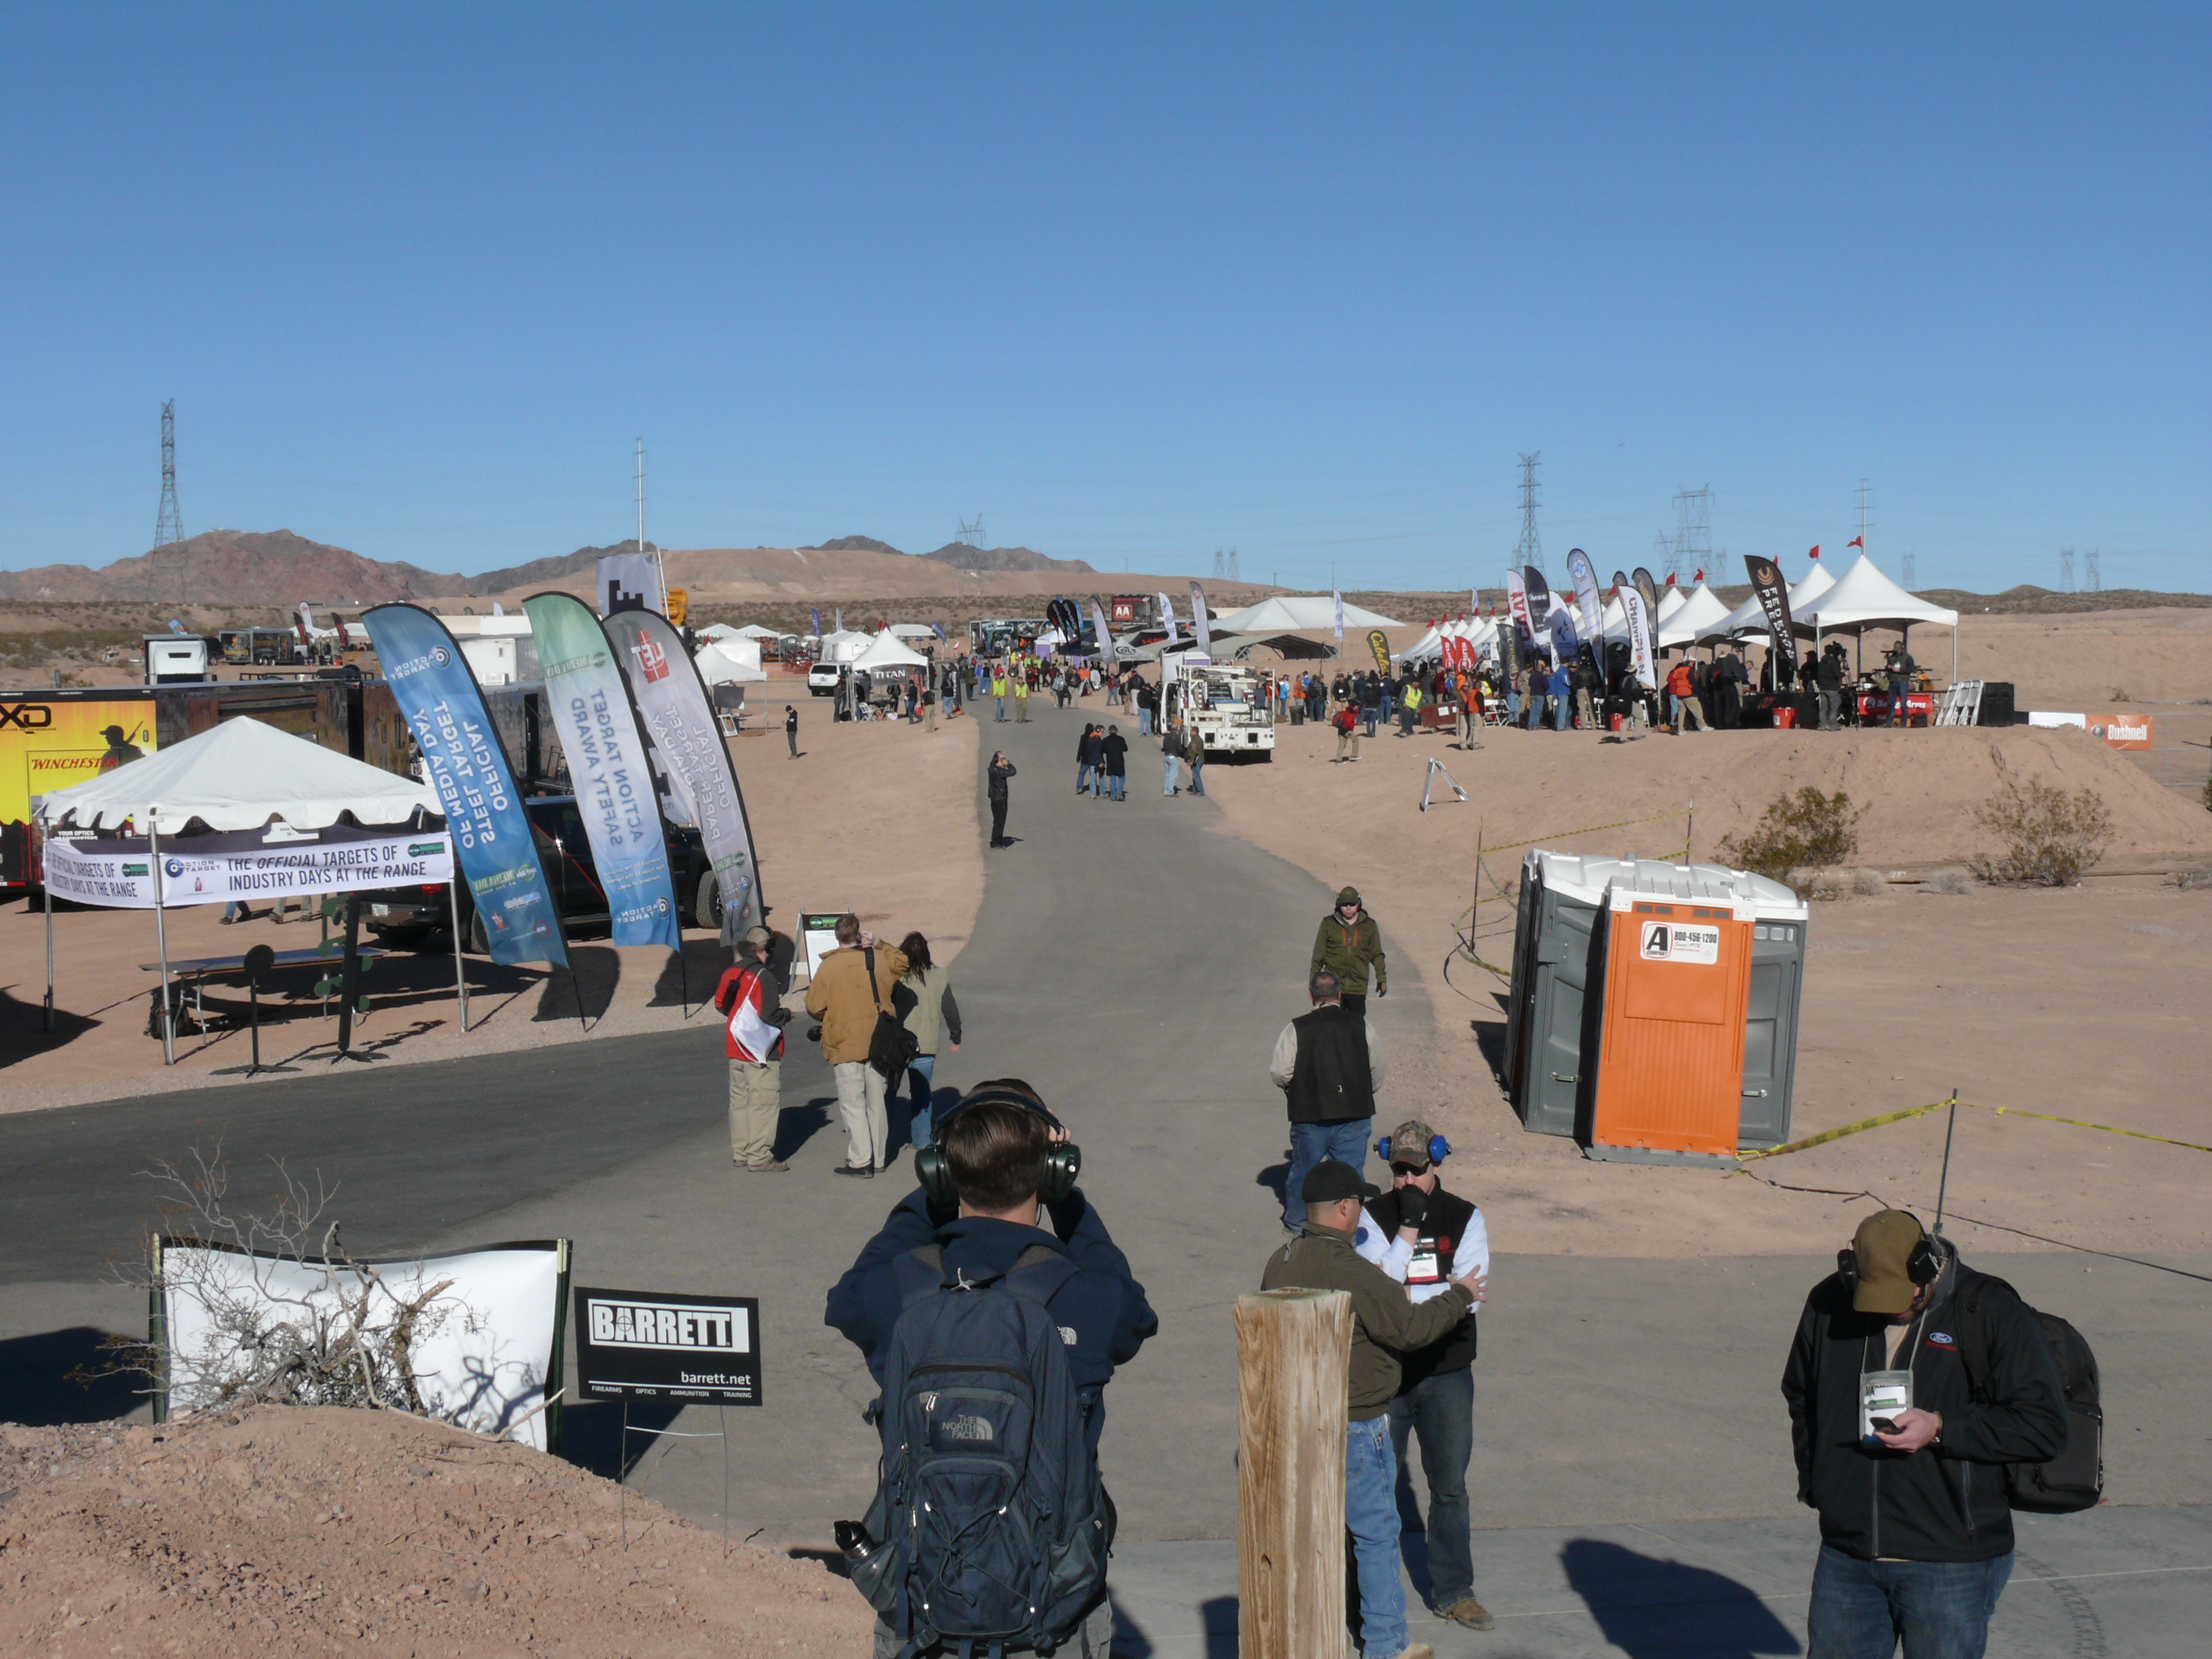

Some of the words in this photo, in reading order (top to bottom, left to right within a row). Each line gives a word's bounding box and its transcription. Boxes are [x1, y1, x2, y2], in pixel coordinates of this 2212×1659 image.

[1629, 596, 1646, 675] CHAMPION
[874, 669, 906, 680] TITAN
[1906, 700, 1926, 709] Arms
[2108, 725, 2147, 740] Bushnell
[32, 757, 117, 770] WINCHESTER
[227, 858, 251, 872] THE
[257, 853, 318, 870] OFFICIAL
[323, 847, 378, 866] TARGETS
[383, 845, 398, 861] OF
[73, 862, 104, 878] TARGETS
[104, 863, 115, 878] OF
[229, 871, 293, 891] INDUSTRY
[300, 868, 332, 885] DAYS
[337, 868, 351, 882] AT
[355, 866, 378, 881] THE
[384, 862, 426, 879] RANGE
[70, 878, 86, 894] DAYS
[86, 880, 95, 896] AT
[94, 881, 109, 897] THE
[110, 882, 137, 897] RANGE
[1646, 927, 1668, 951] A
[1674, 931, 1717, 943] 800-456-1200
[593, 1305, 730, 1346] BARRETT
[682, 1371, 751, 1386] barrett.net
[958, 1415, 976, 1424] THE
[942, 1423, 976, 1433] NORTH
[951, 1430, 976, 1439] FACE
